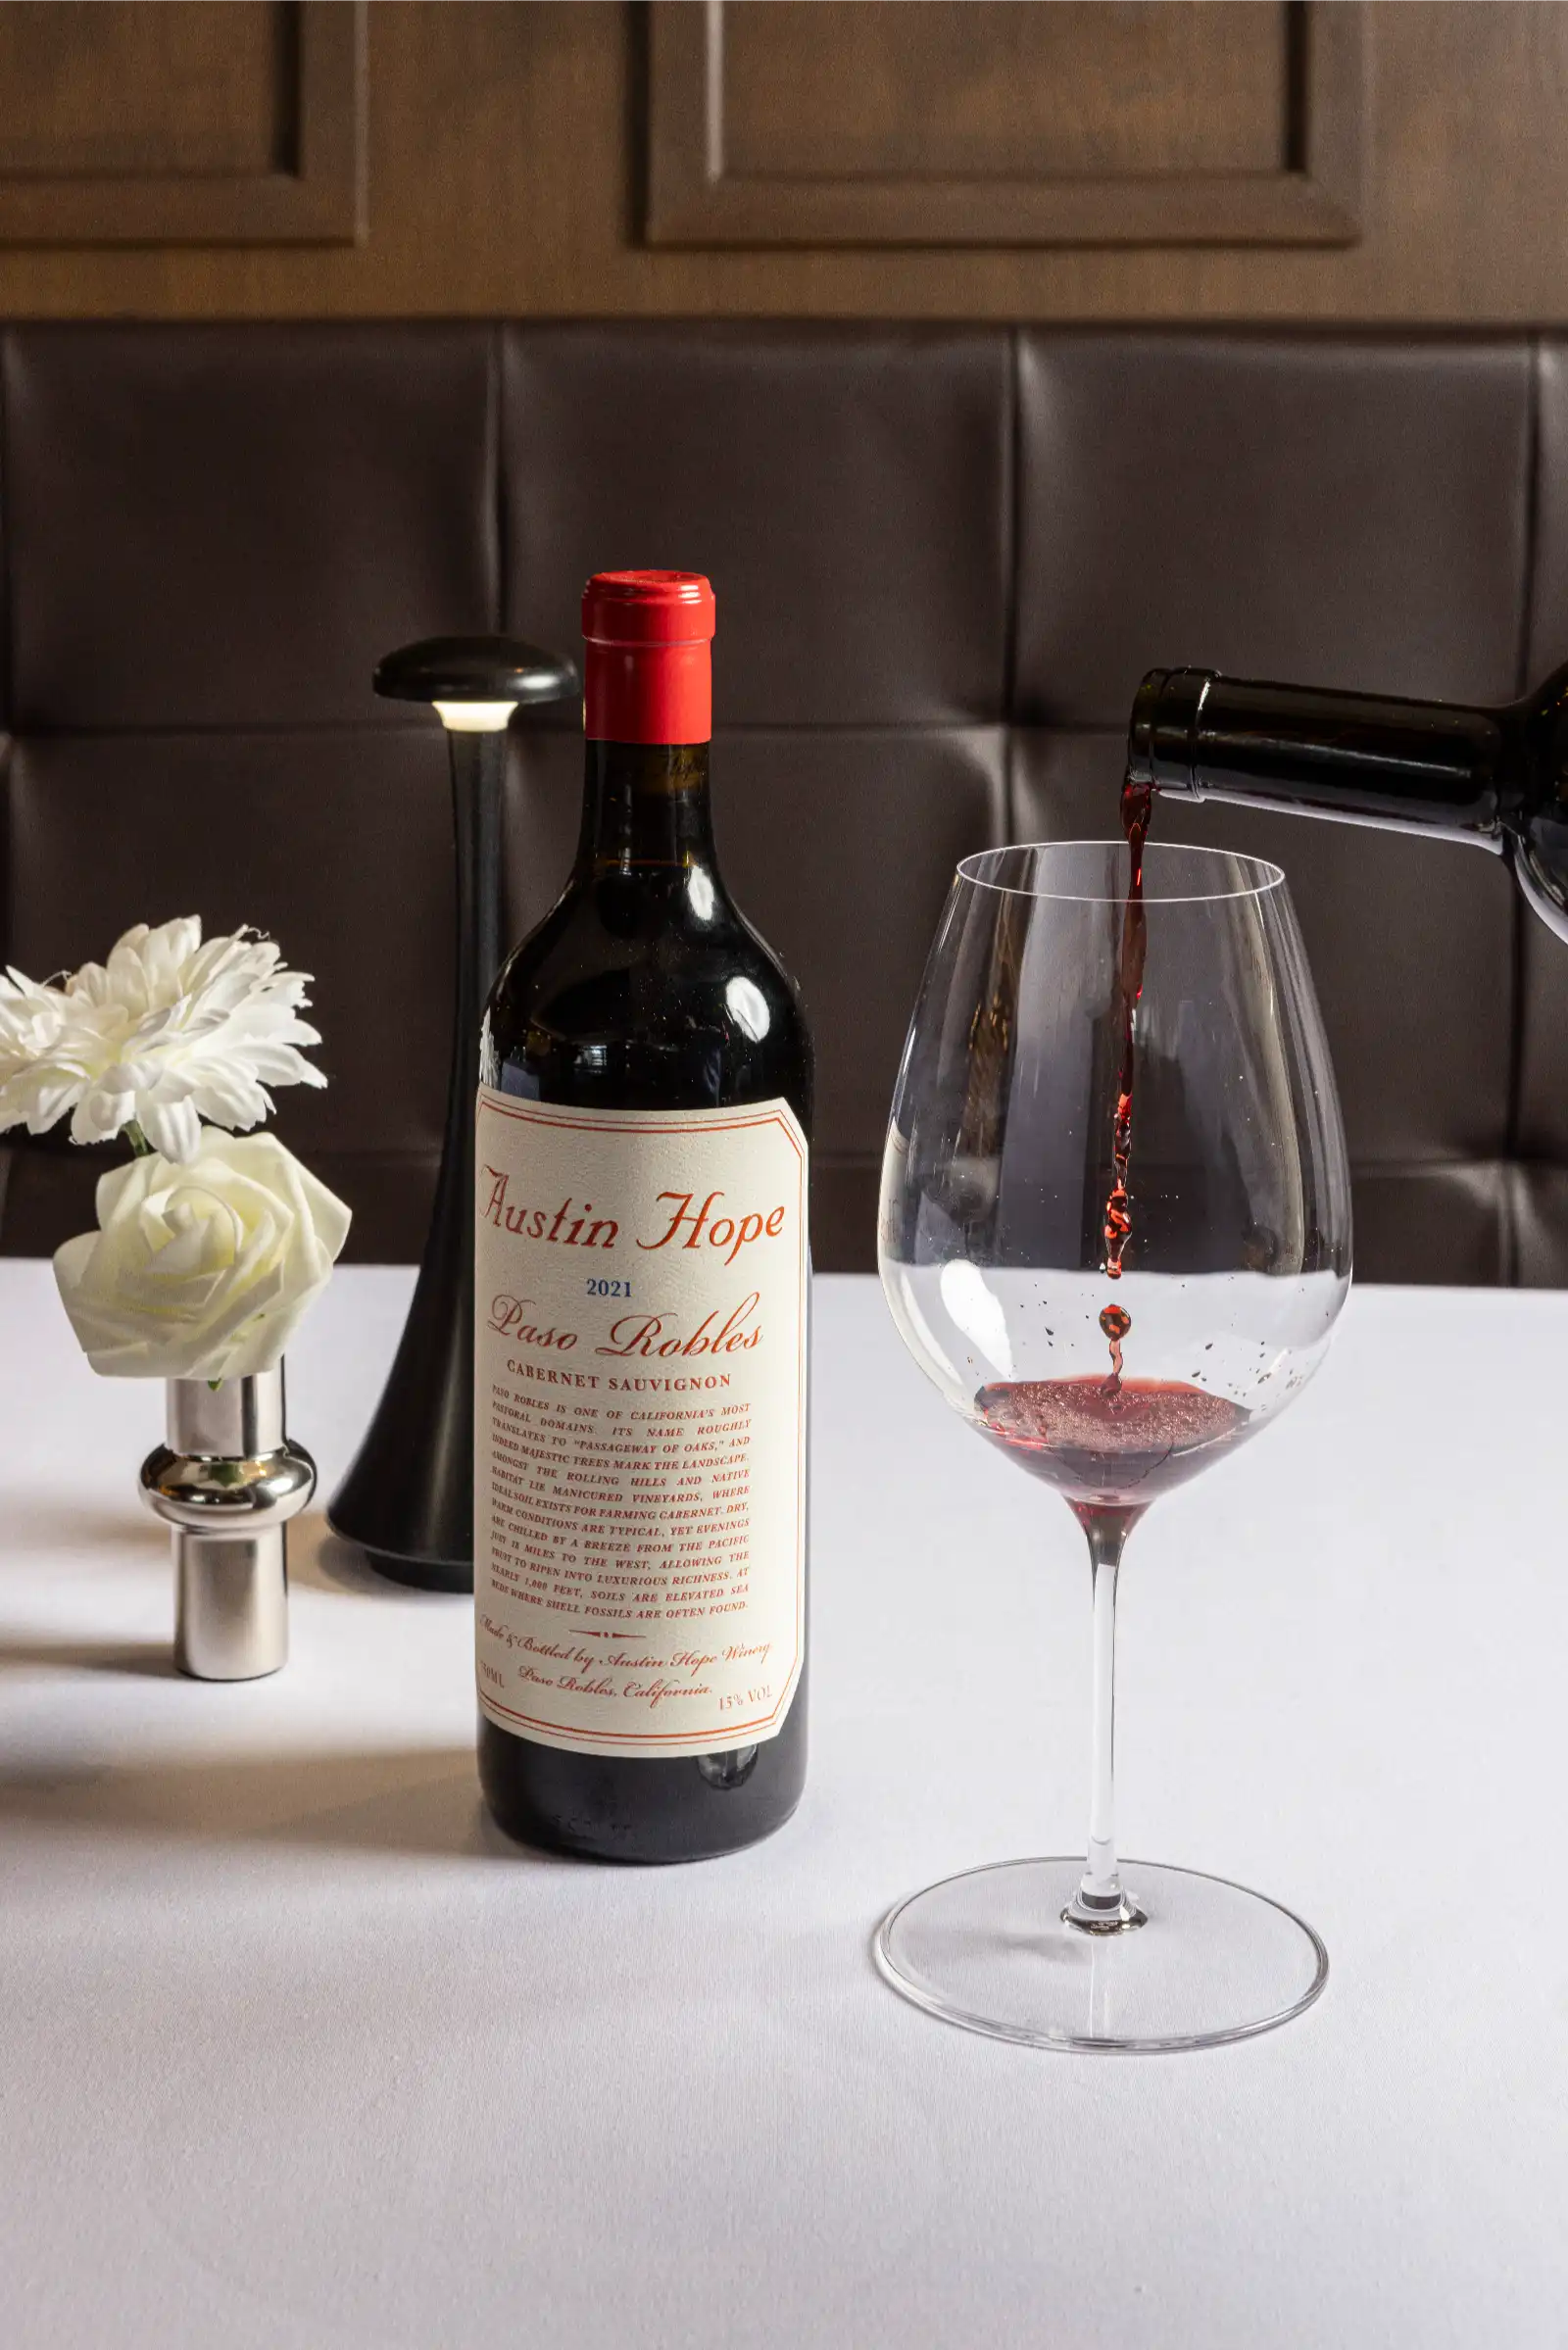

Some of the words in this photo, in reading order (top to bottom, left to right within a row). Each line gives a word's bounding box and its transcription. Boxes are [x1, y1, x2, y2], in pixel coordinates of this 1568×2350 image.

[481, 1163, 618, 1249] Austin
[636, 1191, 785, 1266] Hope
[586, 1278, 632, 1297] 2021
[487, 1294, 578, 1350] Paso
[595, 1292, 763, 1357] Robles
[507, 1359, 600, 1389] CABERNET
[609, 1373, 731, 1392] SAUVIGNON
[492, 1384, 510, 1398] PASO
[514, 1393, 550, 1410] ROBLES
[556, 1403, 566, 1414] IS
[574, 1407, 599, 1419] ONE
[607, 1410, 623, 1420] OF
[720, 1402, 752, 1416] MOST
[492, 1400, 531, 1423] PASTORAL
[612, 1426, 633, 1437] ITS
[647, 1427, 684, 1438] NAME
[697, 1418, 752, 1436] ROUGHLY
[492, 1416, 546, 1443] TRANSLATES
[552, 1436, 566, 1446] TO
[662, 1444, 679, 1453] OF
[728, 1436, 751, 1447] AND
[492, 1434, 519, 1451] INDEED
[521, 1444, 570, 1464] MAJESTIC
[573, 1455, 610, 1468] TREES
[613, 1459, 651, 1470] MARK
[655, 1460, 679, 1470] THE
[492, 1450, 529, 1470] AMONGST
[537, 1466, 558, 1479] THE
[566, 1471, 619, 1486] ROLLING
[630, 1477, 666, 1487] HILLS
[676, 1476, 703, 1487] AND
[711, 1469, 751, 1484] NATIVE
[492, 1465, 525, 1486] HABITAT
[529, 1480, 546, 1492] LIE
[553, 1486, 623, 1502] MANICURED
[632, 1492, 703, 1503] VINEYARDS,
[712, 1486, 751, 1499] WHERE
[492, 1482, 513, 1499] IDEAL
[514, 1492, 534, 1505] SOIL
[535, 1497, 572, 1514] EXISTS
[573, 1506, 597, 1517] FOR
[600, 1509, 656, 1519] FARMING
[492, 1497, 514, 1515] WARM
[515, 1509, 578, 1531] CONDITIONS
[581, 1524, 605, 1535] ARE
[610, 1525, 664, 1537] TYPICAL,
[670, 1525, 694, 1536] YET
[696, 1518, 750, 1534] EVENINGS
[492, 1515, 506, 1528] ARE
[508, 1522, 548, 1542] CHILLED
[553, 1536, 566, 1545] BY
[570, 1539, 578, 1547] A
[584, 1541, 631, 1552] BREEZE
[636, 1543, 673, 1553] FROM
[678, 1541, 703, 1552] THE
[709, 1535, 750, 1549] PACIFIC
[492, 1546, 512, 1563] FRUIT
[514, 1557, 527, 1568] TO
[529, 1562, 561, 1577] RIPEN
[564, 1570, 593, 1583] INTO
[597, 1574, 667, 1586] LUXURIOUS
[737, 1567, 750, 1578] AT
[524, 1544, 556, 1559] MILES
[562, 1552, 576, 1563] TO
[584, 1556, 609, 1567] THE
[615, 1559, 651, 1570] WEST,
[659, 1556, 722, 1569] ALLOWING
[729, 1550, 750, 1563] THE
[491, 1562, 520, 1582] NEARLY
[553, 1584, 583, 1598] FEET,
[590, 1591, 626, 1601] SOILS
[632, 1592, 659, 1603] ARE
[665, 1588, 724, 1602] ELEVATED
[730, 1583, 750, 1595] SEA
[491, 1578, 510, 1593] BEDS
[511, 1589, 543, 1605] WHERE
[546, 1599, 580, 1614] SHELL
[584, 1605, 632, 1619] FOSSILS
[636, 1608, 662, 1619] ARE
[665, 1607, 707, 1619] OFTEN
[517, 1636, 574, 1660] Bottled
[573, 1647, 594, 1674] by
[599, 1651, 665, 1667] Austin
[670, 1650, 717, 1677] Hope
[722, 1642, 771, 1664] Winery
[517, 1665, 554, 1687] Paso
[718, 1693, 743, 1711] 15%
